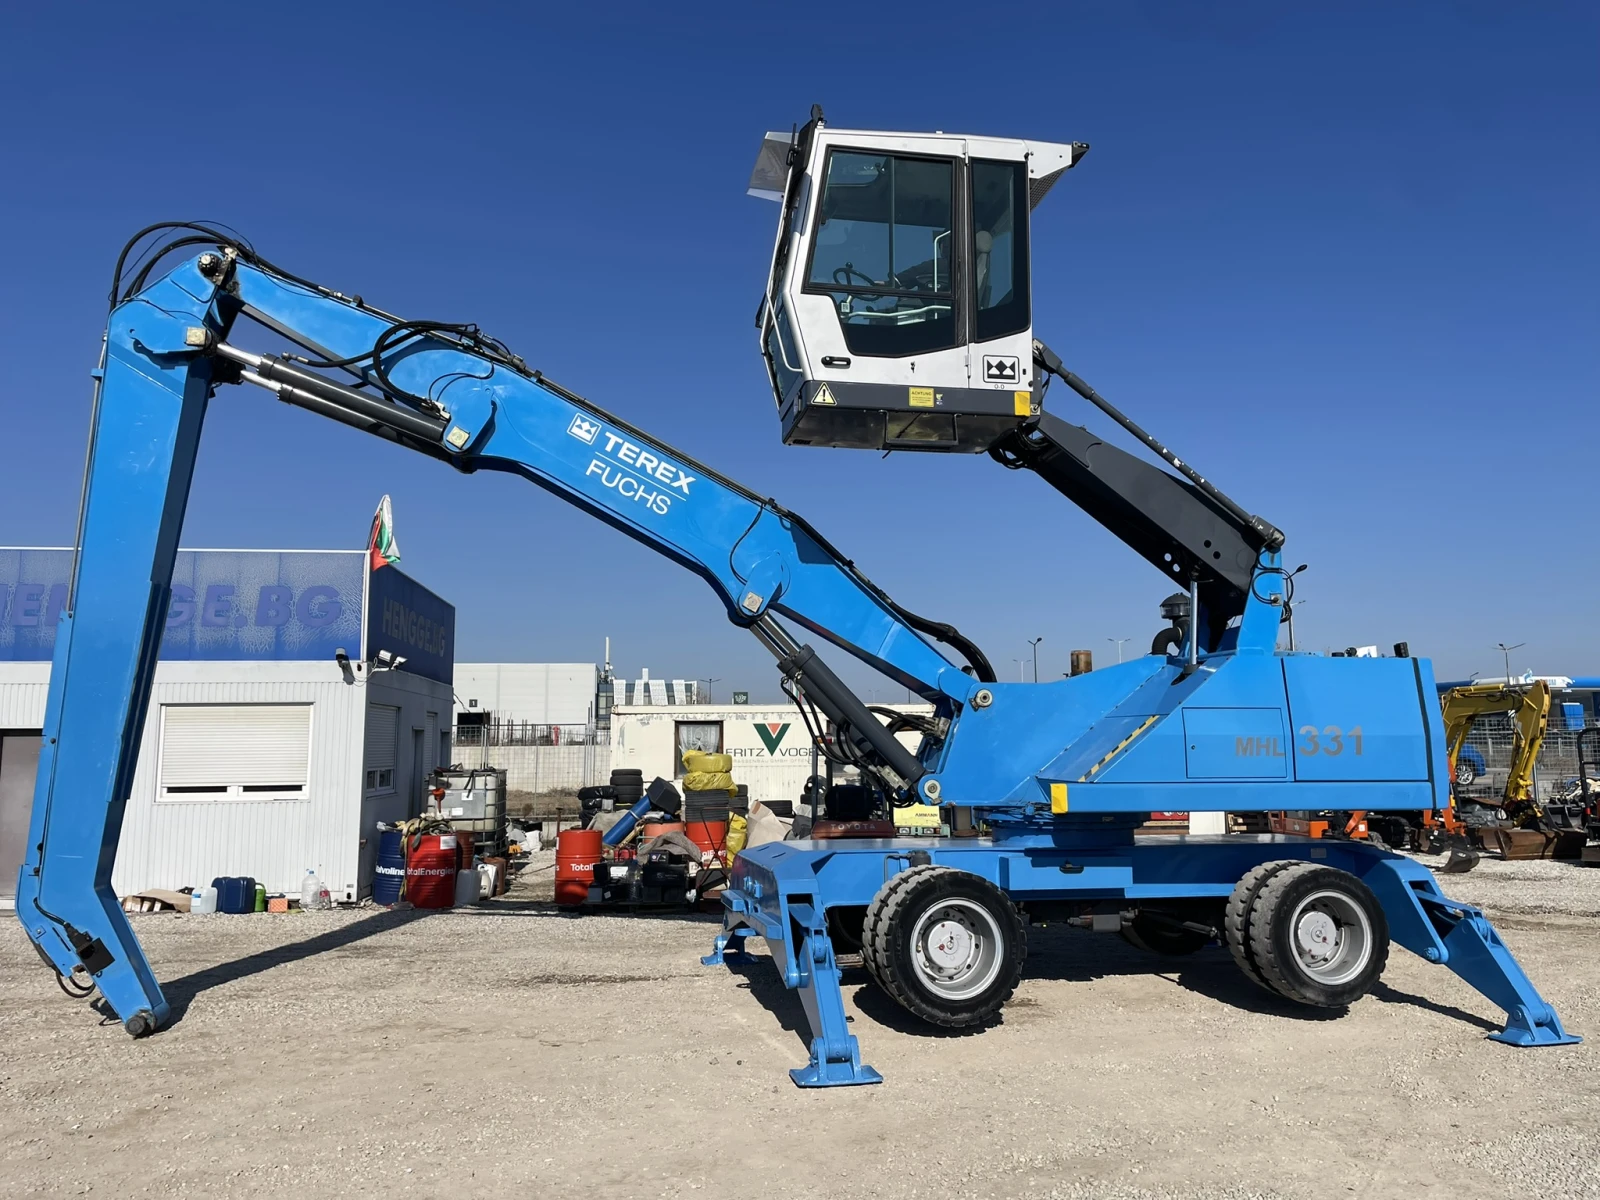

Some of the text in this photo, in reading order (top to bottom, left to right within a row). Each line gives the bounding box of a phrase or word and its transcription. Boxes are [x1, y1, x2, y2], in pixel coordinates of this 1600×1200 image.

[585, 459, 671, 515] FUCHS
[604, 431, 696, 495] TEREX
[382, 596, 446, 658] HENGGE.BG
[725, 748, 765, 757] FRITZ
[1235, 725, 1364, 757] MHL 331
